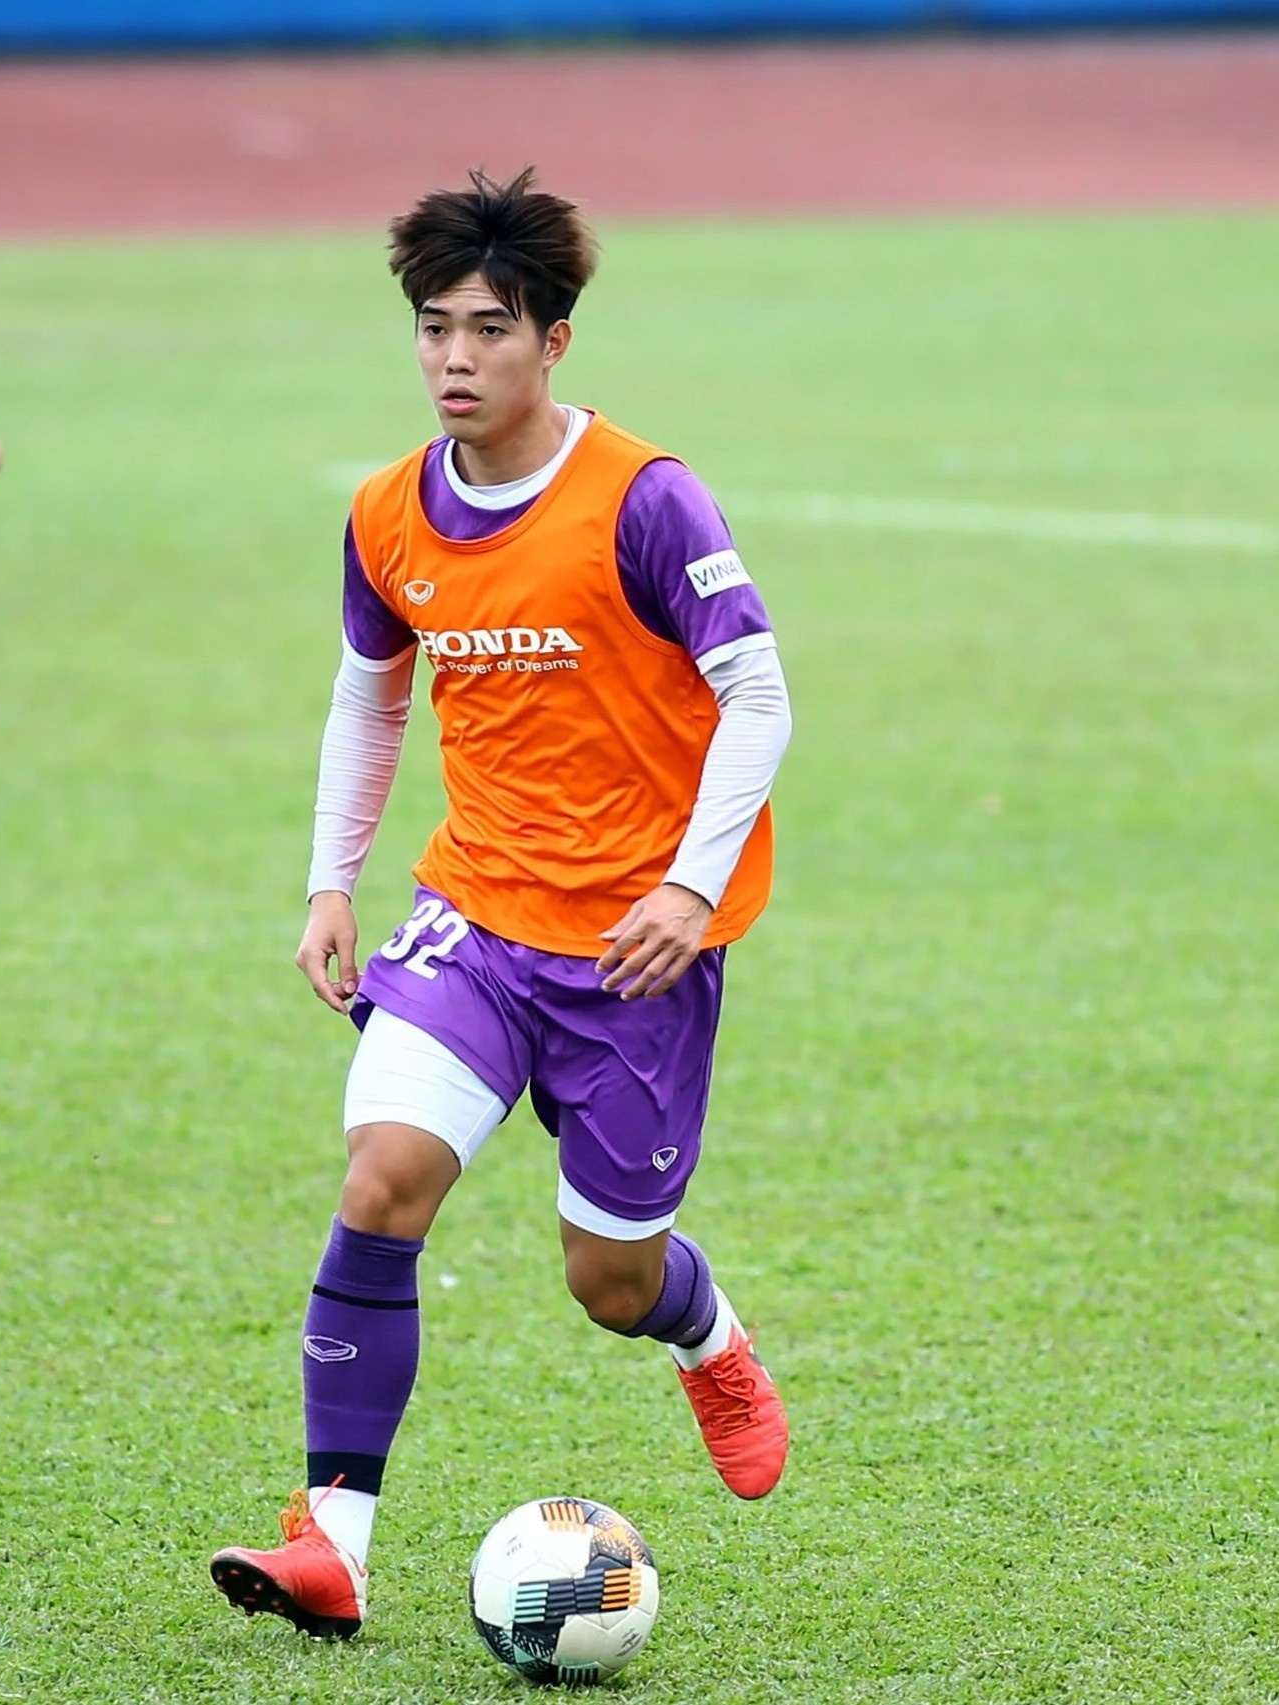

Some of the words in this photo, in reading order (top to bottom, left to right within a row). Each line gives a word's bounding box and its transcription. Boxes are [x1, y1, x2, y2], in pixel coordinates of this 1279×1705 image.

[412, 627, 583, 658] HONDA
[446, 661, 493, 675] Power
[496, 659, 512, 672] of
[515, 658, 579, 673] Dreams
[380, 899, 469, 980] 32
